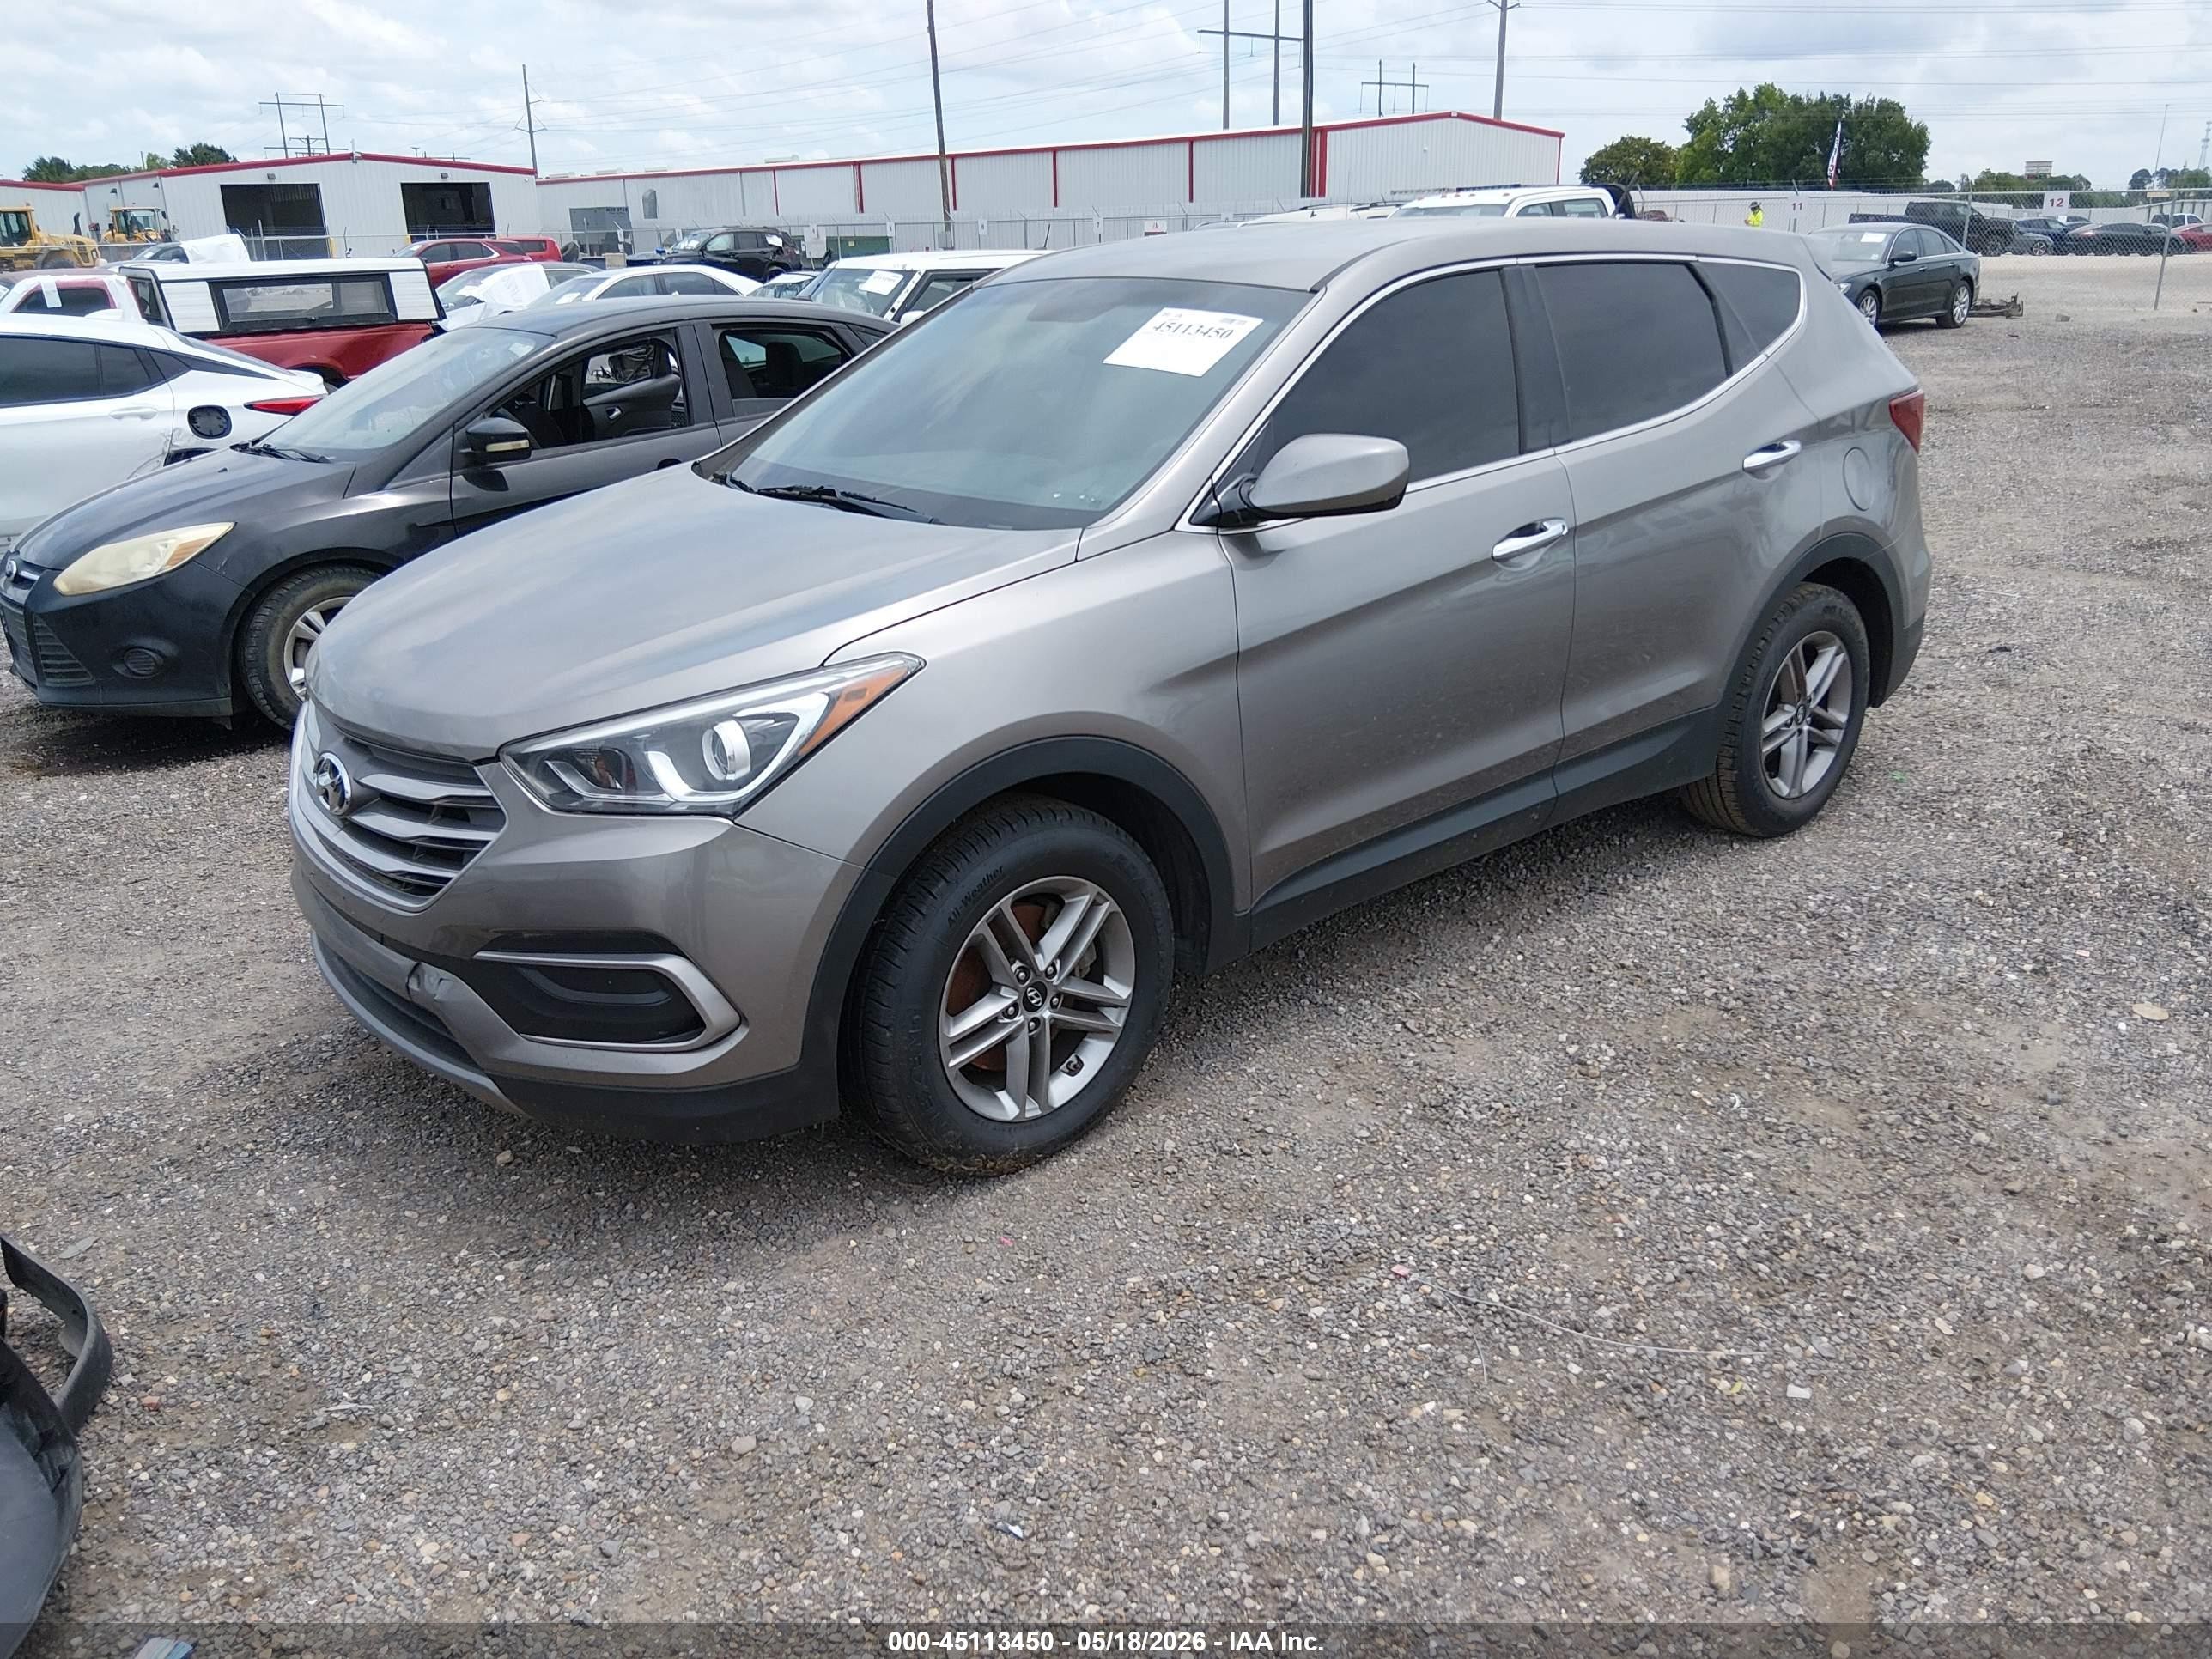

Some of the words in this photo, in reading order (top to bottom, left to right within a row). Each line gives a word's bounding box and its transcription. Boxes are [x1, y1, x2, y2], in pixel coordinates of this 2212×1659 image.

[1792, 202, 1803, 211] 11
[2049, 198, 2064, 207] 12
[1153, 321, 1234, 339] 45113450
[947, 865, 1004, 928] All-Weather
